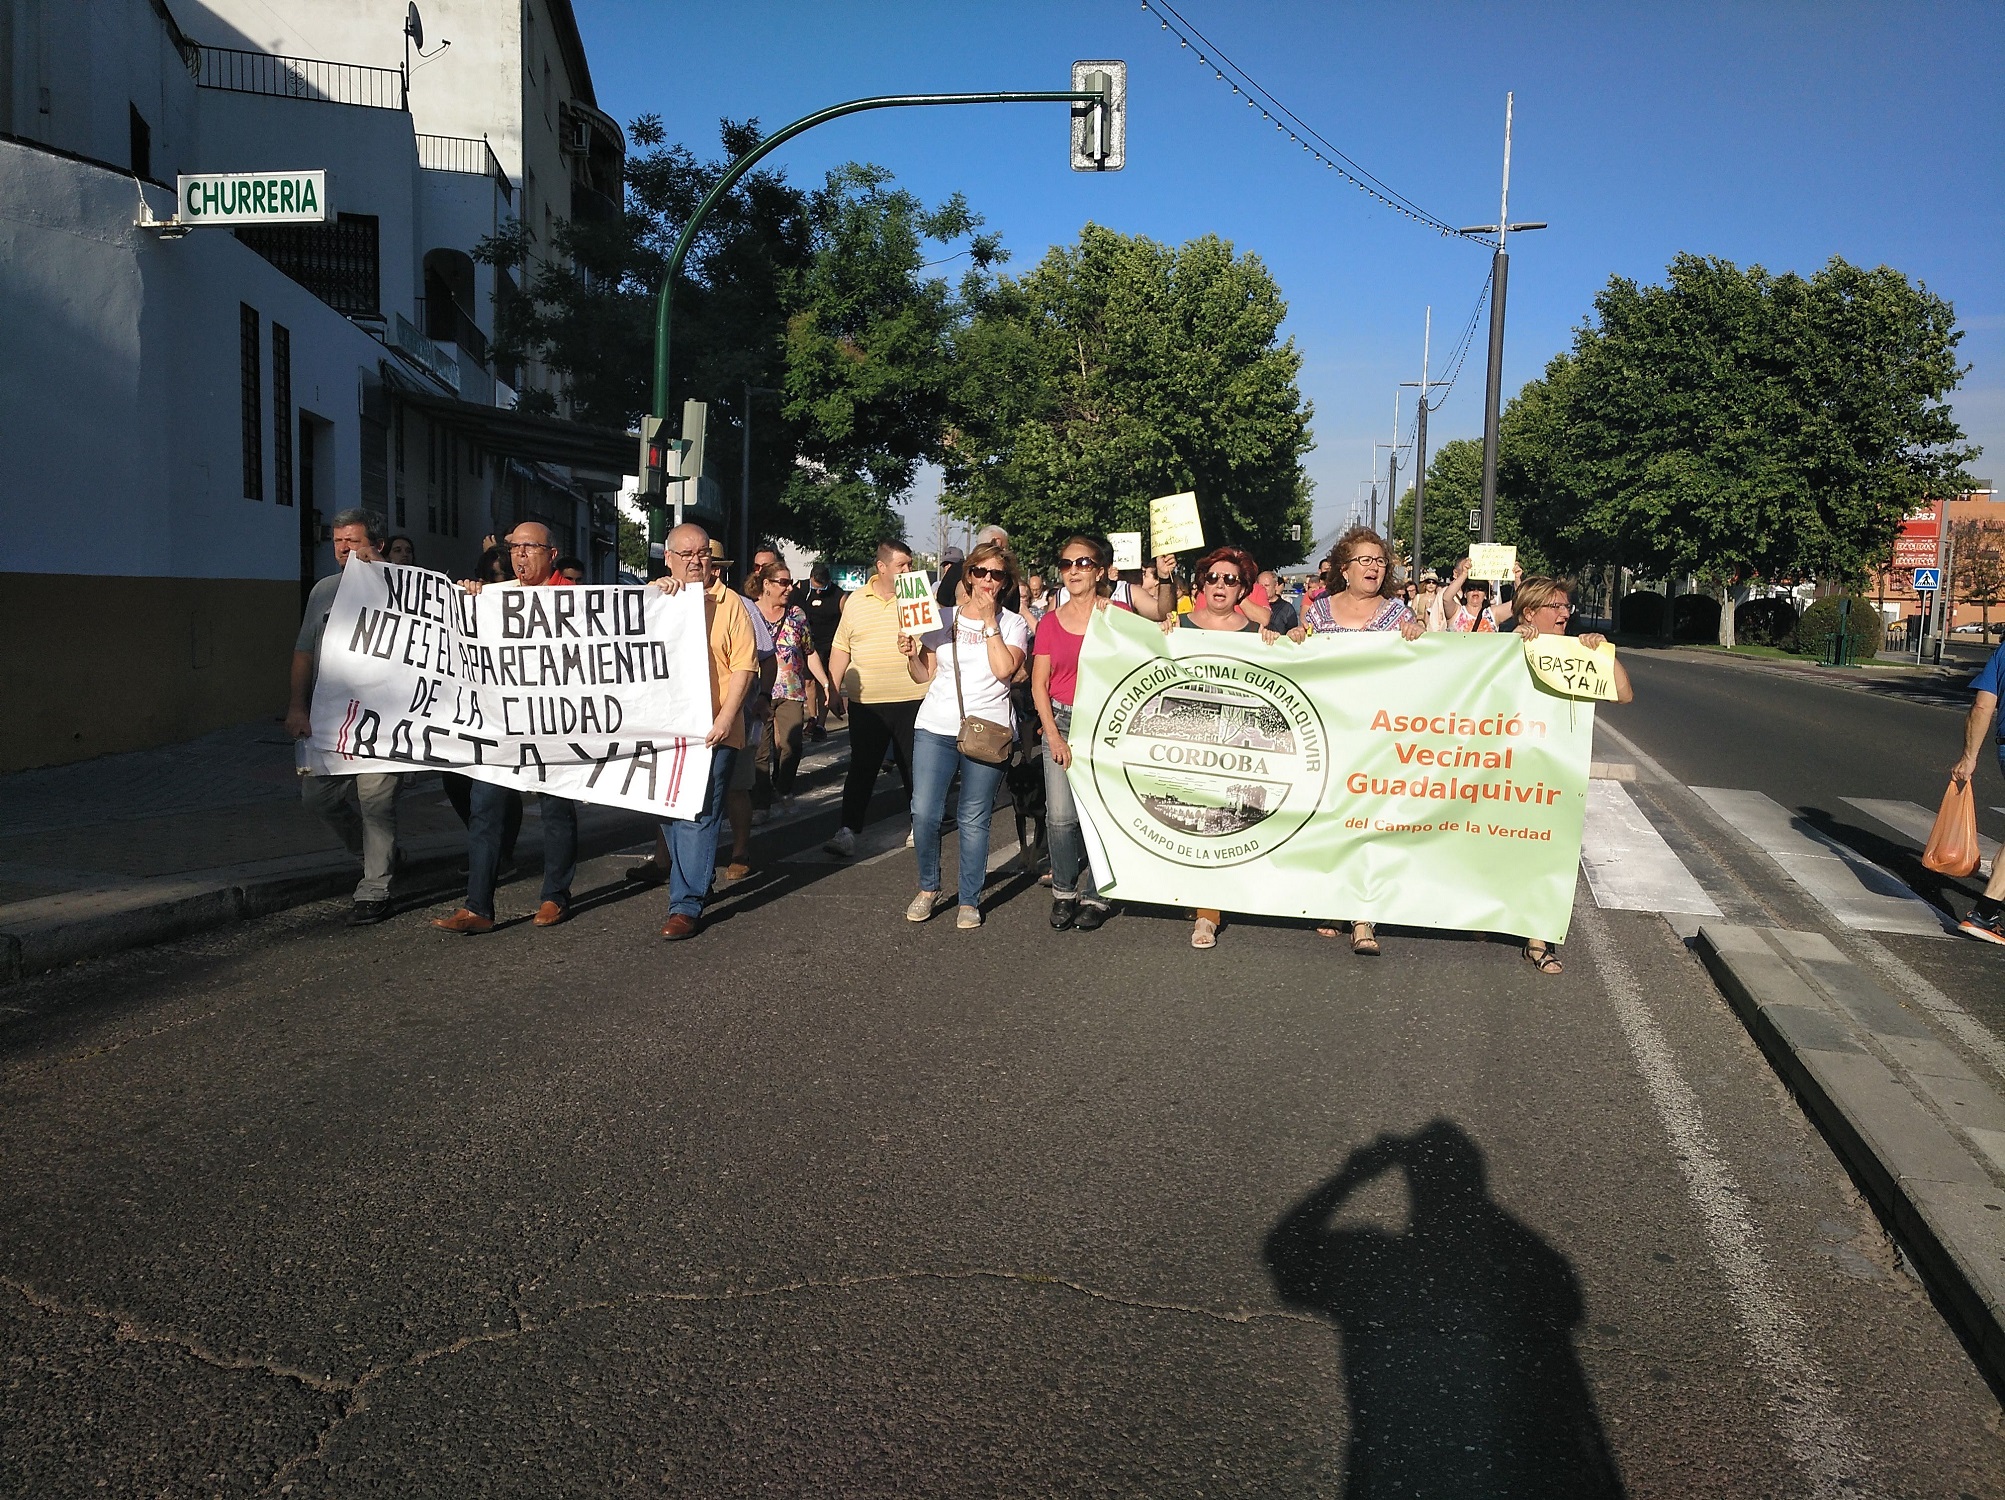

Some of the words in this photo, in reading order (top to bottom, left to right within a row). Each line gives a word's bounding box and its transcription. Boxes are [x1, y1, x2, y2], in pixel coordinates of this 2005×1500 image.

[187, 179, 317, 215] CHURRERIA
[501, 588, 645, 639] BARRIO
[349, 606, 401, 660] NO
[403, 619, 432, 669] ES
[436, 627, 455, 677] EL
[458, 641, 669, 686] APARCAMIENTO
[409, 676, 442, 718] DE
[453, 686, 483, 729] LA
[502, 695, 622, 735] CIUDAD
[1104, 664, 1178, 748] ASOCIACIÓN
[1244, 671, 1321, 773] GUADALQUIVIR
[1370, 709, 1547, 739] Asociación
[1149, 743, 1270, 776] CORDOBA
[1395, 743, 1513, 769] Vecinal
[1346, 773, 1562, 805] Guadalquivir
[1133, 817, 1174, 850] CAMPO
[1177, 844, 1193, 858] DE
[1196, 849, 1210, 860] LA
[1213, 839, 1260, 860] VERDAD
[1345, 817, 1368, 829] del
[1374, 819, 1433, 834] Campo
[1438, 821, 1460, 832] de
[1466, 821, 1481, 834] la
[1487, 824, 1552, 841] Verdad
